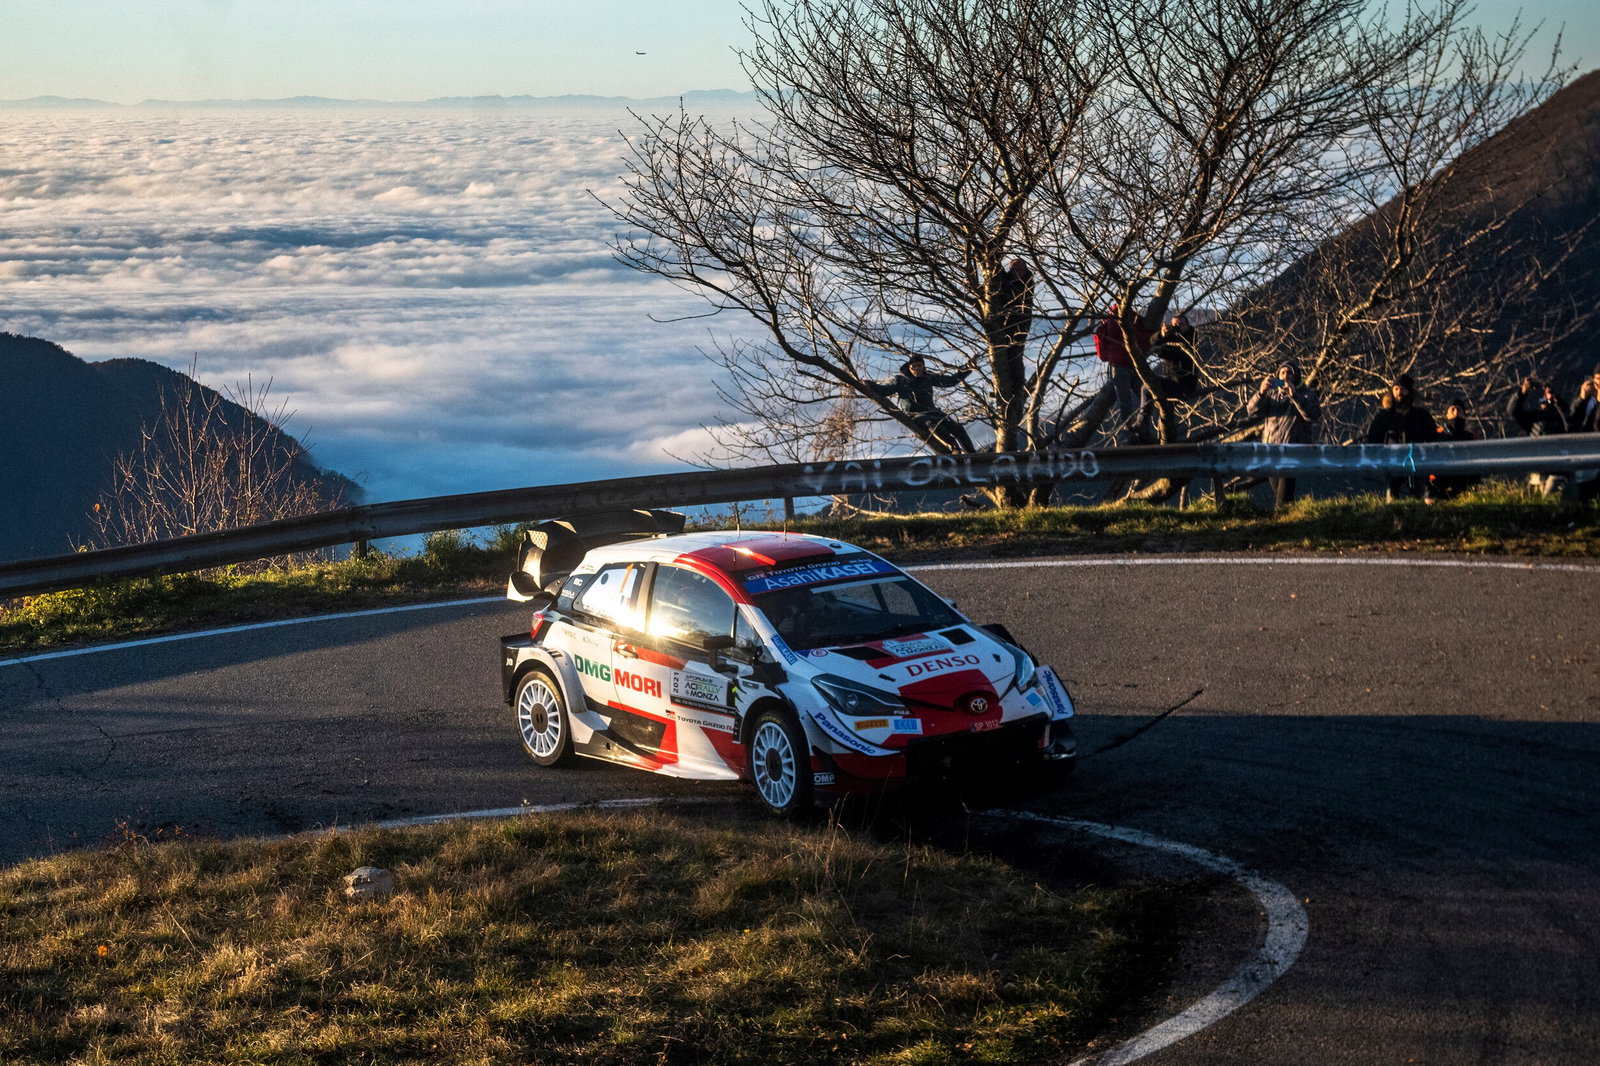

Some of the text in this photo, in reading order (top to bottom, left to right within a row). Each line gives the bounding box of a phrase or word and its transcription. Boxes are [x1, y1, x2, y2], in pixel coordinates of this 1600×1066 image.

[803, 451, 1099, 492] VAI ORLANDO
[764, 563, 880, 590] AsahiKASEI
[767, 566, 805, 576] TOYOTA
[574, 654, 662, 698] DMG MORI
[906, 655, 980, 677] DENSO
[690, 690, 719, 702] MONZA
[1043, 670, 1068, 714] Panasonic
[677, 716, 702, 724] TOYOTA
[815, 712, 876, 754] Panasonic
[814, 774, 835, 783] OMP
